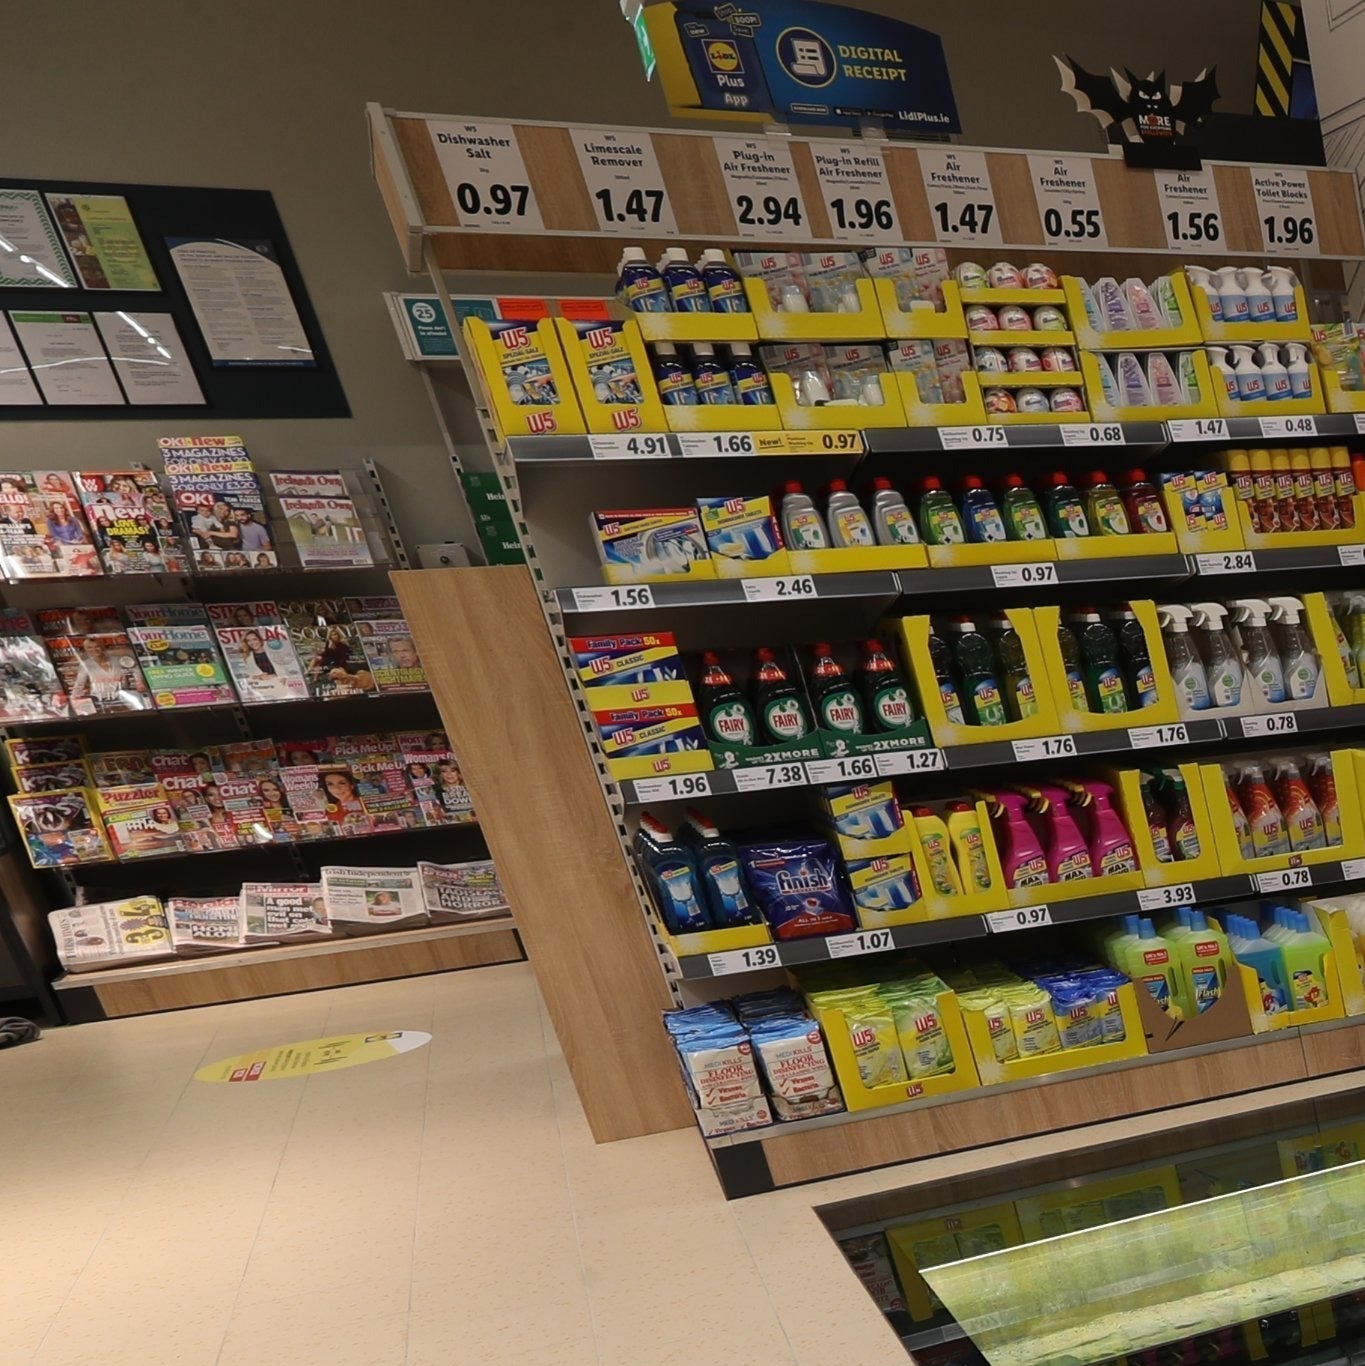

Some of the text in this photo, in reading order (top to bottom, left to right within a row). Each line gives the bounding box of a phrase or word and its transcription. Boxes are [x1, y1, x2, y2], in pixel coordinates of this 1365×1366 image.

[838, 44, 902, 62] DIGITAL
[842, 64, 906, 82] RECEIPT
[717, 74, 744, 88] Plus
[725, 92, 748, 107] App
[899, 111, 949, 124] LidlPlus.ie
[437, 133, 510, 147] Dishwasher
[466, 148, 491, 159] Salt
[584, 143, 642, 155] Limescale
[591, 156, 643, 167] Remover
[734, 151, 775, 163] Plug-in
[815, 155, 880, 167] Plug-in Refill
[724, 162, 790, 174] Air Freshener
[819, 167, 882, 179] Air Freshener
[946, 161, 961, 171] Air
[1054, 166, 1068, 176] Air
[931, 172, 980, 184] Freshener
[1040, 177, 1086, 188] Freshener
[1178, 173, 1190, 183] Air
[1254, 178, 1306, 190] Active Power
[1164, 184, 1207, 194] Freshener
[1256, 189, 1308, 200] Toilet Blocks
[457, 182, 529, 216] 0.97
[596, 189, 664, 222] 1.47
[737, 195, 801, 226] 2.94
[830, 199, 893, 230] 1.96
[935, 202, 993, 234] 1.47
[1044, 208, 1100, 238] 0.55
[1167, 212, 1219, 241] 1.56
[1264, 216, 1313, 244] 1.96
[416, 308, 432, 320] 25
[500, 326, 532, 350] W5
[586, 326, 616, 349] W5
[526, 411, 557, 434] W5
[612, 408, 642, 432] W5
[1195, 419, 1223, 435] 1.47
[1285, 416, 1312, 432] 0.48
[972, 426, 1003, 442] 0.75
[1089, 425, 1121, 442] 0.68
[626, 436, 666, 454] 4.91
[713, 434, 752, 452] 1.66
[759, 438, 782, 447] New!
[822, 433, 856, 449] 0.97
[172, 448, 246, 457] MAGAZINES
[181, 474, 253, 483] MAGAZINES
[320, 476, 343, 486] Own
[172, 483, 224, 491] FOR ONLY
[182, 493, 214, 506] OK!
[327, 501, 352, 509] Own
[1223, 554, 1252, 570] 2.84
[1021, 566, 1053, 582] 0.97
[776, 579, 813, 597] 2.46
[610, 589, 649, 607] 1.56
[588, 640, 617, 649] Family
[643, 637, 660, 645] 50x
[589, 655, 644, 674] W5 CLASSIC
[631, 688, 650, 702] W5
[611, 711, 639, 720] Family
[665, 708, 682, 716] 50x
[830, 707, 855, 720] FAIRY
[882, 703, 906, 716] FAIRY
[719, 719, 744, 732] FAIRY
[773, 714, 798, 728] FAIRY
[1266, 716, 1295, 731] 0.78
[612, 726, 666, 745] W5 CLASSIC
[1156, 726, 1186, 743] 1.76
[336, 744, 377, 754] Pick Me
[1041, 739, 1073, 755] 1.76
[152, 754, 188, 766] Chat
[906, 752, 938, 769] 1.27
[352, 763, 393, 772] Pick Me
[838, 760, 872, 776] 1.66
[766, 766, 801, 784] 7.38
[163, 777, 205, 789] Chat
[220, 783, 256, 797] Chat
[286, 781, 318, 790] Weekly
[668, 776, 707, 796] 1.96
[103, 789, 160, 802] Puzzler
[777, 871, 830, 893] finish
[1282, 871, 1309, 884] 0.78
[1163, 887, 1192, 902] 3.93
[277, 898, 301, 906] good
[441, 900, 500, 908] HORROR
[1017, 908, 1047, 925] 0.97
[856, 932, 890, 950] 1.07
[742, 950, 777, 967] 1.39
[773, 1059, 825, 1075] DISINFECTING
[780, 1055, 815, 1068] FLOOR
[700, 1070, 753, 1083] DISINFECTING
[708, 1065, 744, 1077] FLOOR
[793, 1082, 819, 1093] Bacteria
[719, 1093, 746, 1101] Bacteria
